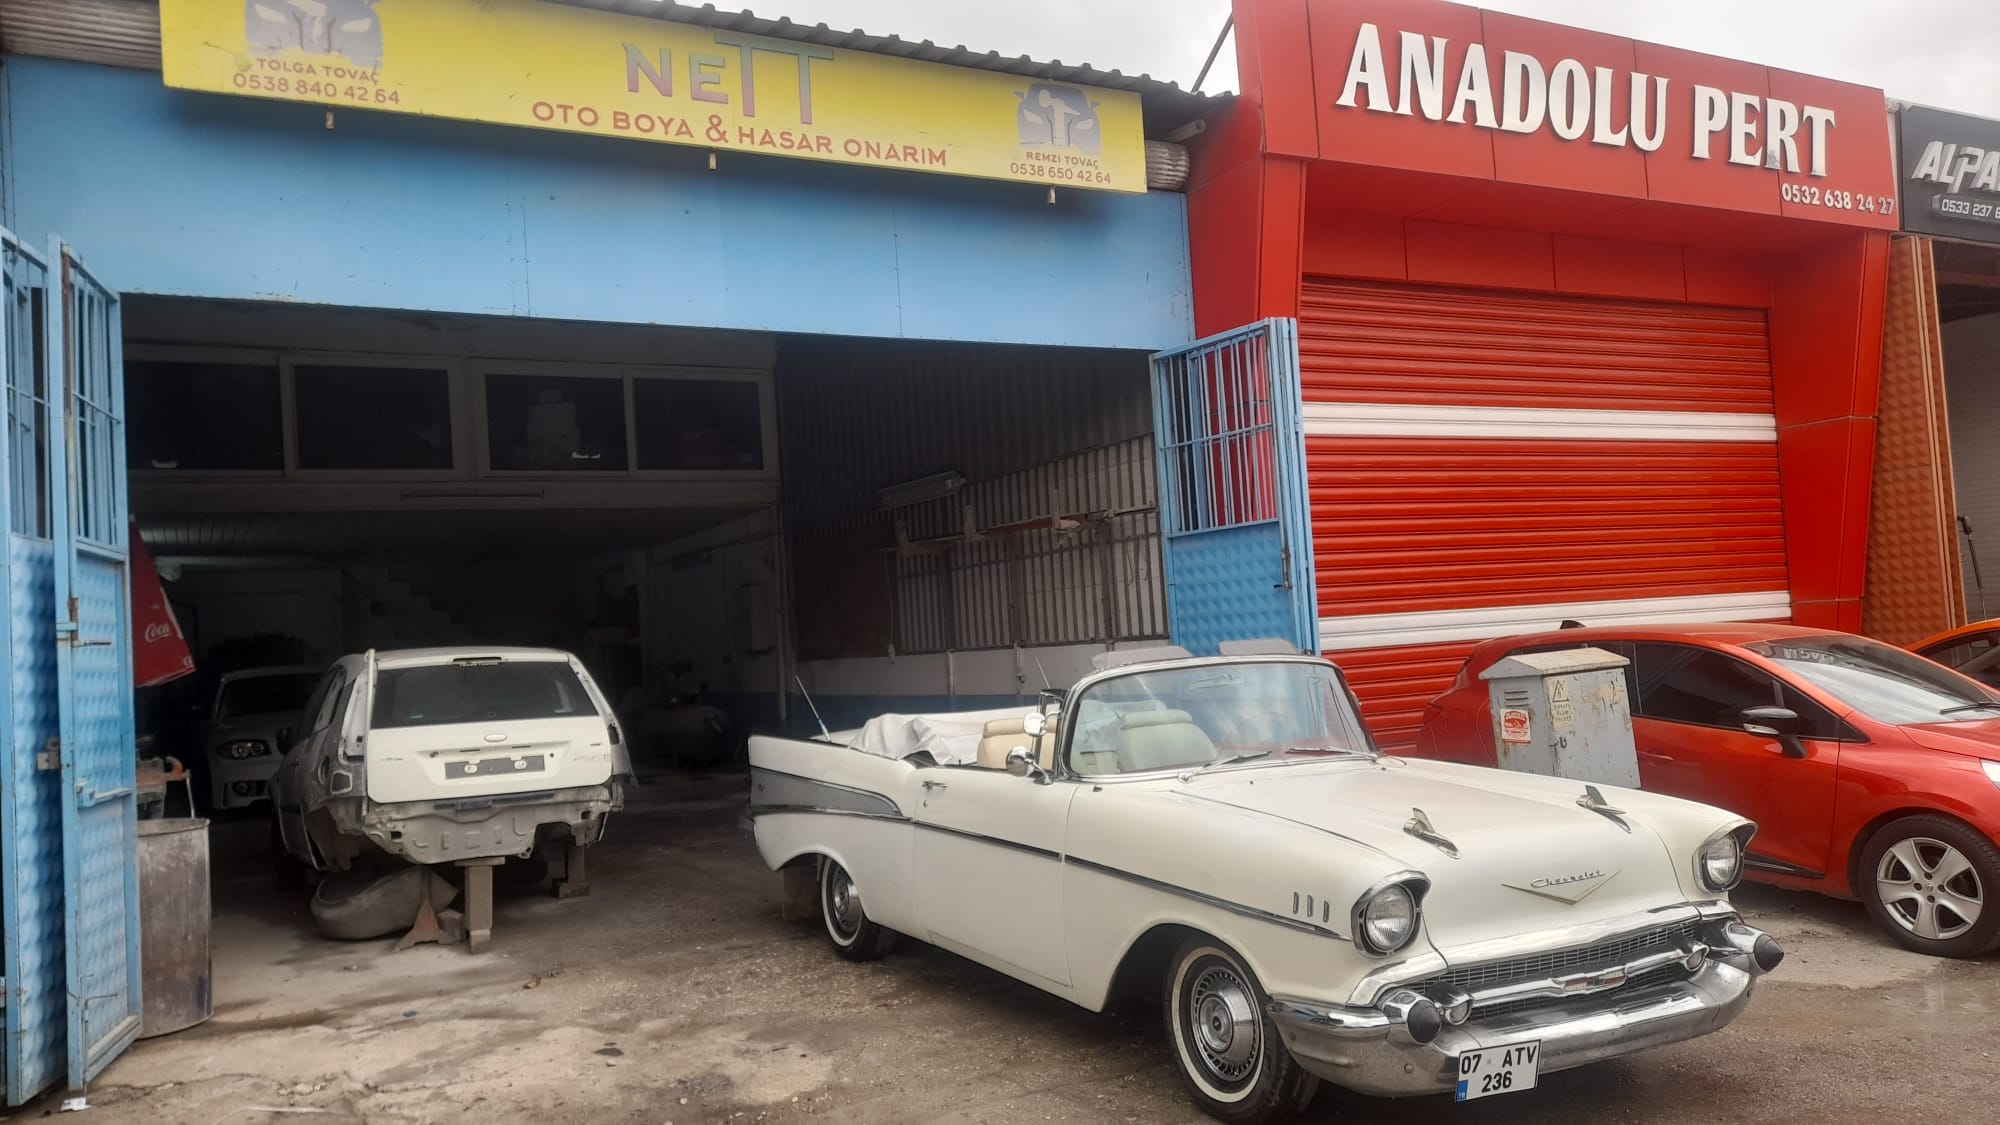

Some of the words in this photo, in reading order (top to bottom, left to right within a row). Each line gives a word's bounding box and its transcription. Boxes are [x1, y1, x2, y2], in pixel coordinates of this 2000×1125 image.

[256, 57, 317, 76] TOLGA
[323, 65, 380, 86] TOVAÇ
[233, 72, 289, 92] 0538
[295, 79, 337, 98] 840
[344, 85, 369, 102] 42
[375, 88, 401, 105] 64
[1335, 22, 1670, 151] ANADOLU
[1692, 83, 1836, 177] PERT
[532, 101, 599, 127] OTO
[612, 110, 694, 138] BOYA
[705, 114, 729, 143] &
[738, 126, 833, 154] HASAR
[843, 138, 947, 166] ONARIM
[1010, 162, 1045, 177] 0538
[1048, 167, 1074, 180] 650
[1076, 171, 1093, 183] 42
[1095, 172, 1111, 184] 64
[1026, 151, 1062, 163] REMZI
[1064, 155, 1100, 170] TOVAÇ
[1910, 140, 2000, 194] ALPA
[1781, 182, 1820, 205] 0532
[1824, 189, 1852, 210] 638
[1856, 193, 1875, 212] 24
[1878, 196, 1895, 215] 27
[1941, 199, 1970, 215] 0533
[1972, 203, 1993, 217] 237
[144, 623, 171, 643] Coca
[1530, 869, 1606, 888] Chevrolet
[1461, 1054, 1482, 1075] 07
[1502, 1045, 1537, 1068] ATV
[1481, 1070, 1513, 1093] 236
